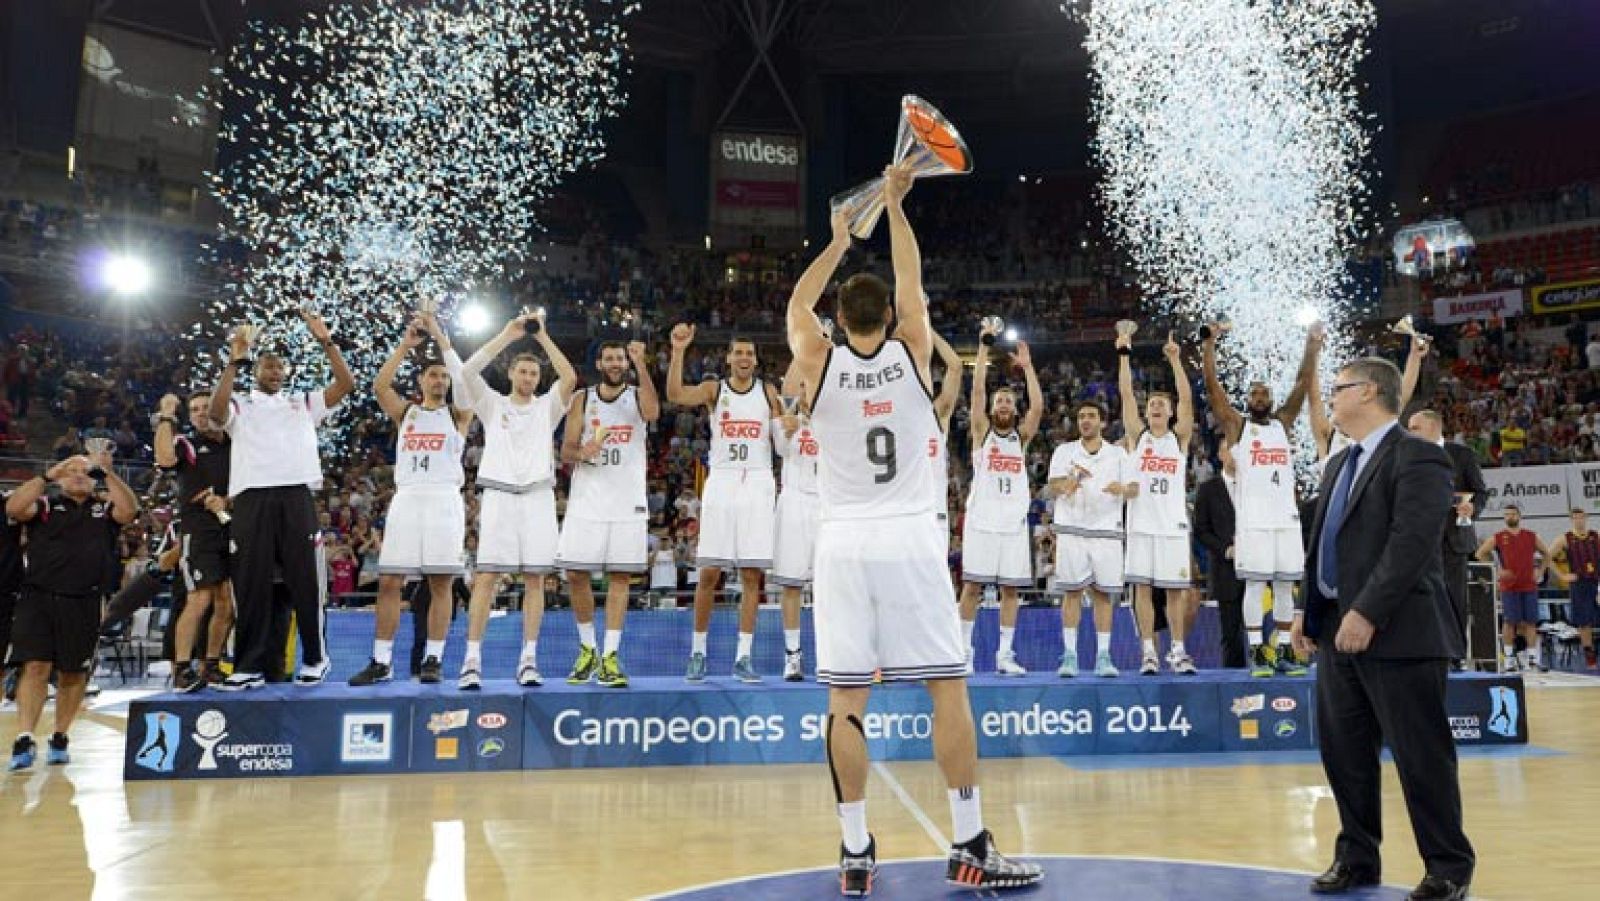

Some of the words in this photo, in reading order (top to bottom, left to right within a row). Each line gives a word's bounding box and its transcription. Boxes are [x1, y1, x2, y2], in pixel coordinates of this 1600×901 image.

[722, 137, 799, 165] endesa
[719, 420, 762, 438] Teka
[402, 433, 446, 452] Teka
[601, 448, 620, 465] 30
[729, 444, 749, 461] 50
[866, 426, 897, 484] 9
[412, 455, 430, 472] 14
[997, 477, 1011, 494] 13
[1150, 477, 1169, 494] 20
[1271, 470, 1280, 486] 4
[1502, 482, 1561, 498] Añana
[554, 709, 784, 754] Campeones
[981, 703, 1093, 737] endesa
[1106, 705, 1193, 737] 2014
[216, 743, 293, 759] supercopa
[239, 757, 293, 771] endesa
